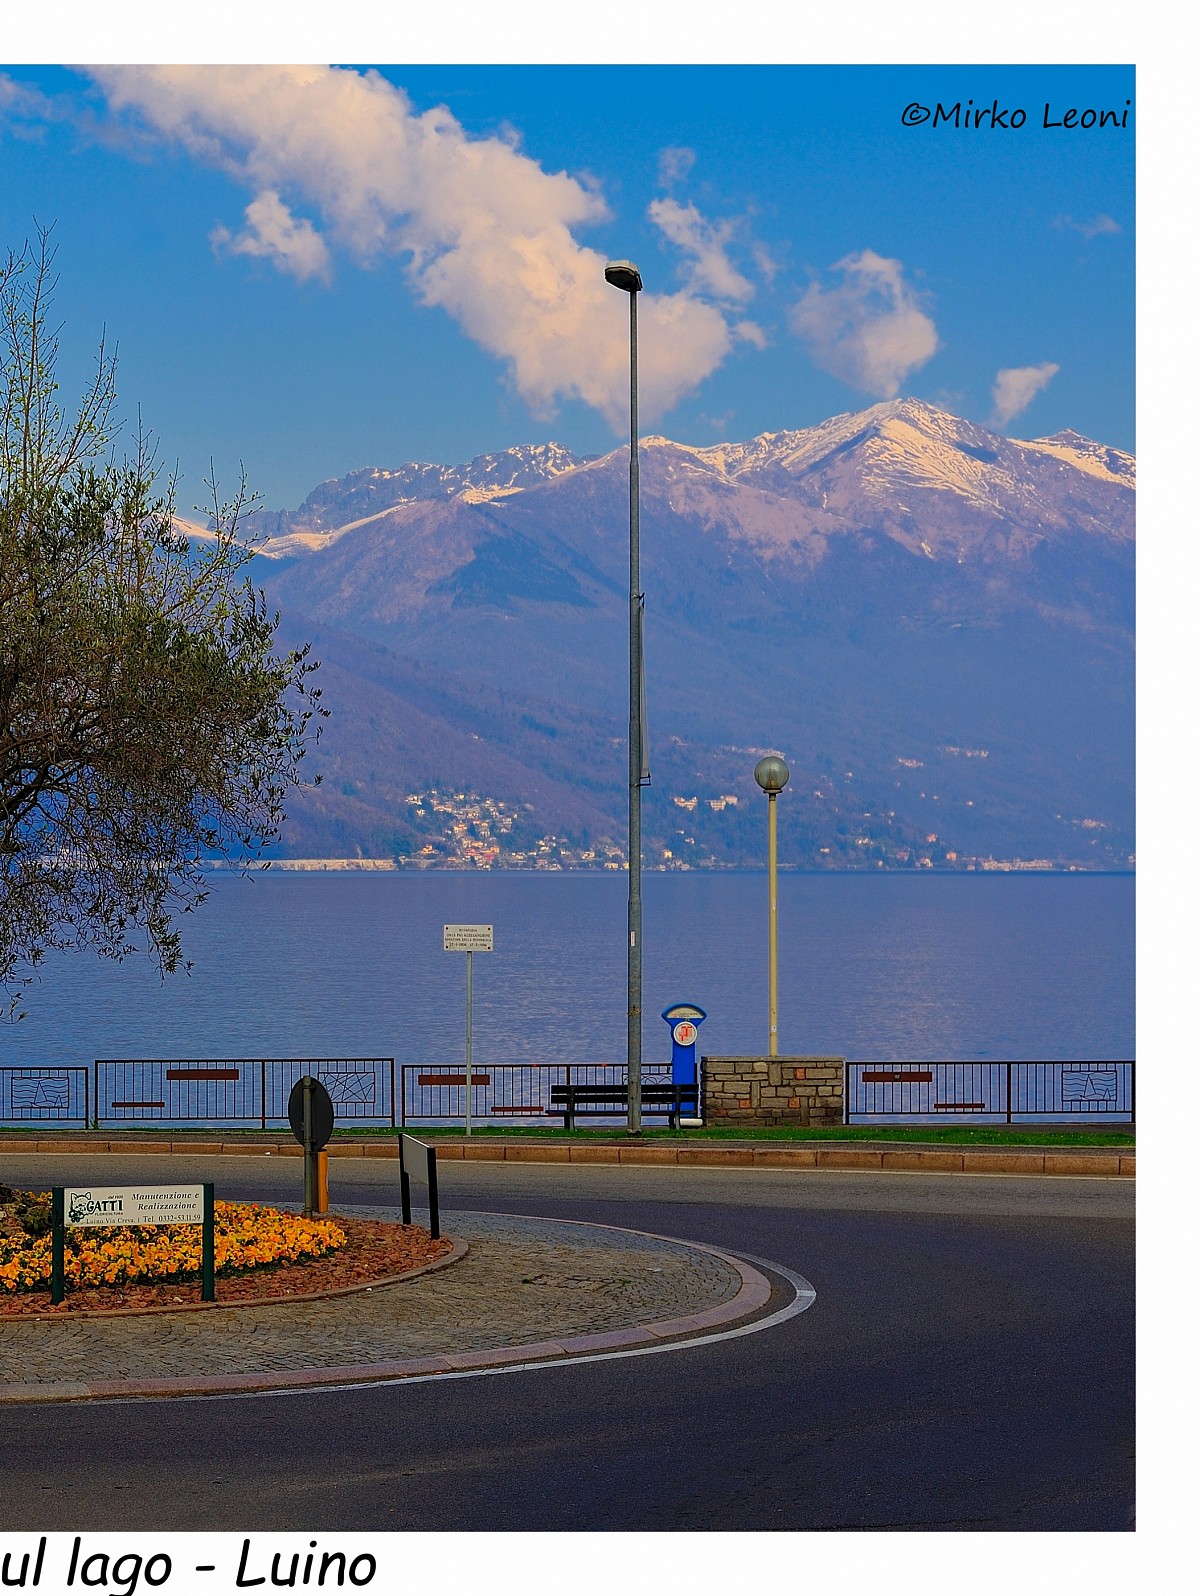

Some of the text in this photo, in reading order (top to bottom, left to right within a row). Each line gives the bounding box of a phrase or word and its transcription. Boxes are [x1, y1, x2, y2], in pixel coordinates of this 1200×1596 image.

[131, 1191, 192, 1201] Manutenzione
[86, 1200, 123, 1212] GATTI
[137, 1201, 197, 1211] Realizzazione
